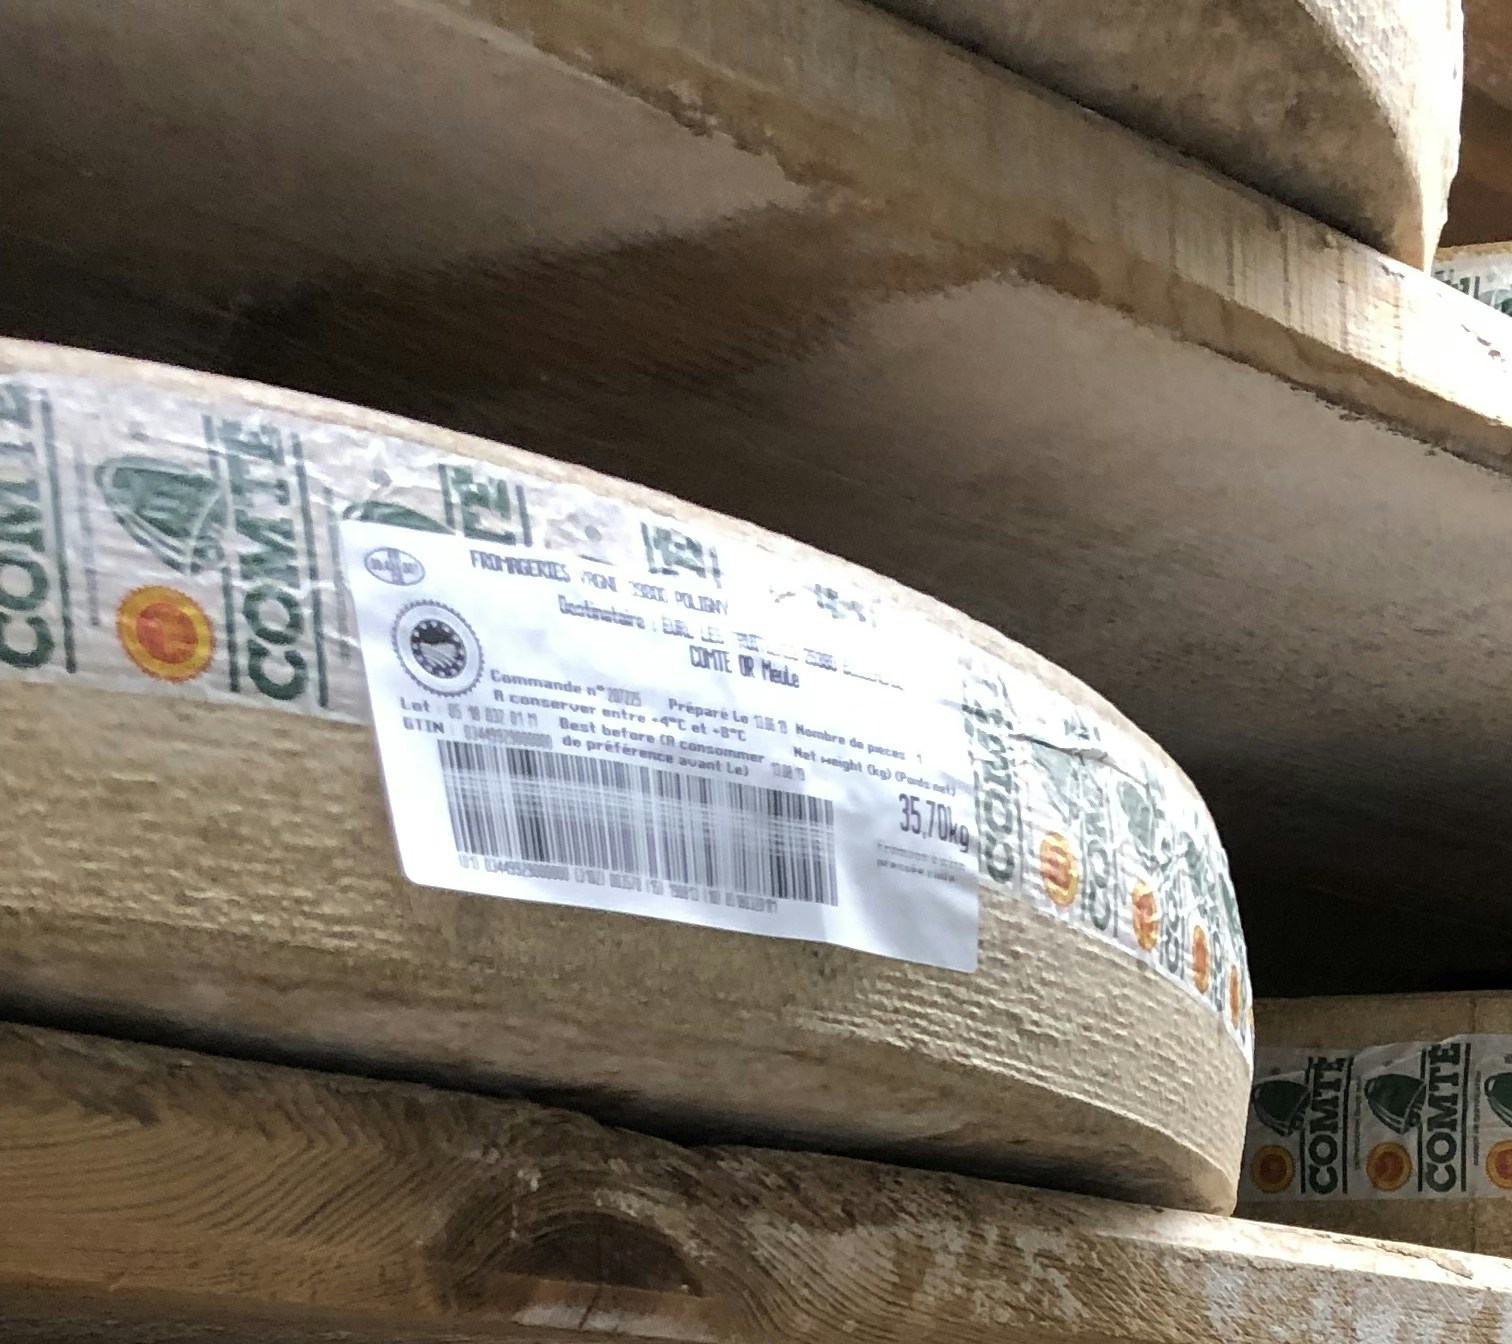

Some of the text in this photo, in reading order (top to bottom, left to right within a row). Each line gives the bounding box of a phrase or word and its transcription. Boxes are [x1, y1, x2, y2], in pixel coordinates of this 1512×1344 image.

[470, 550, 570, 582] FROMAGERIES
[490, 669, 581, 693] Commande
[689, 645, 732, 673] COMTE
[762, 659, 799, 688] Meule
[510, 693, 596, 714] conserver
[602, 707, 645, 723] entre
[559, 717, 597, 734] Best
[602, 724, 655, 744] before
[680, 740, 765, 764] consommer
[795, 722, 845, 745] Nombre
[678, 756, 722, 773] avant
